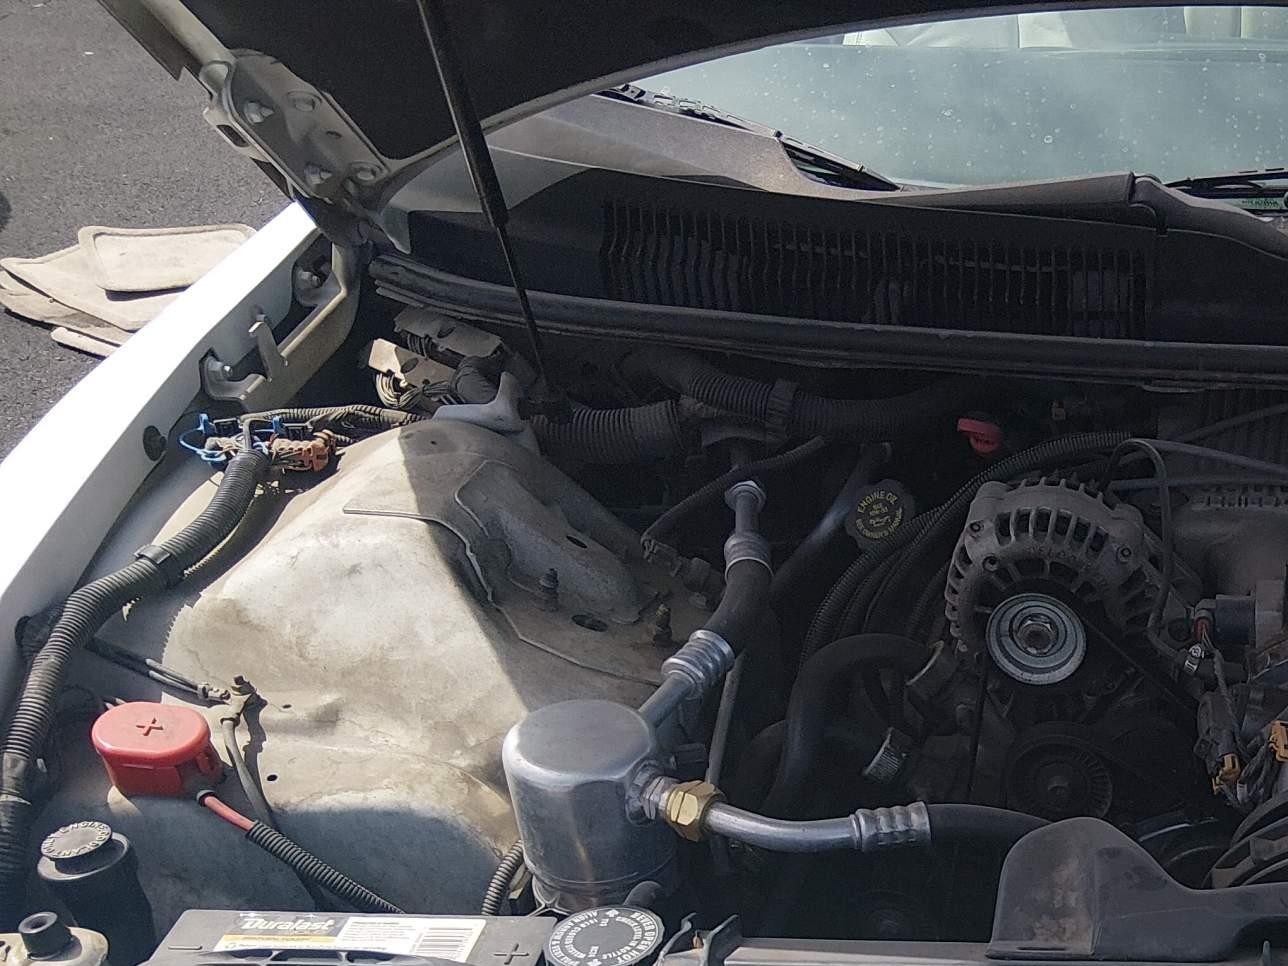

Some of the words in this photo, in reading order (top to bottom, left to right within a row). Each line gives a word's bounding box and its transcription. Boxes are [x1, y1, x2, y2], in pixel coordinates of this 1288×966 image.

[241, 918, 336, 930] Duralast
[630, 911, 656, 931] NEVER
[637, 931, 656, 950] OPEN
[601, 945, 631, 960] BOTTLE
[616, 949, 640, 964] HOT
